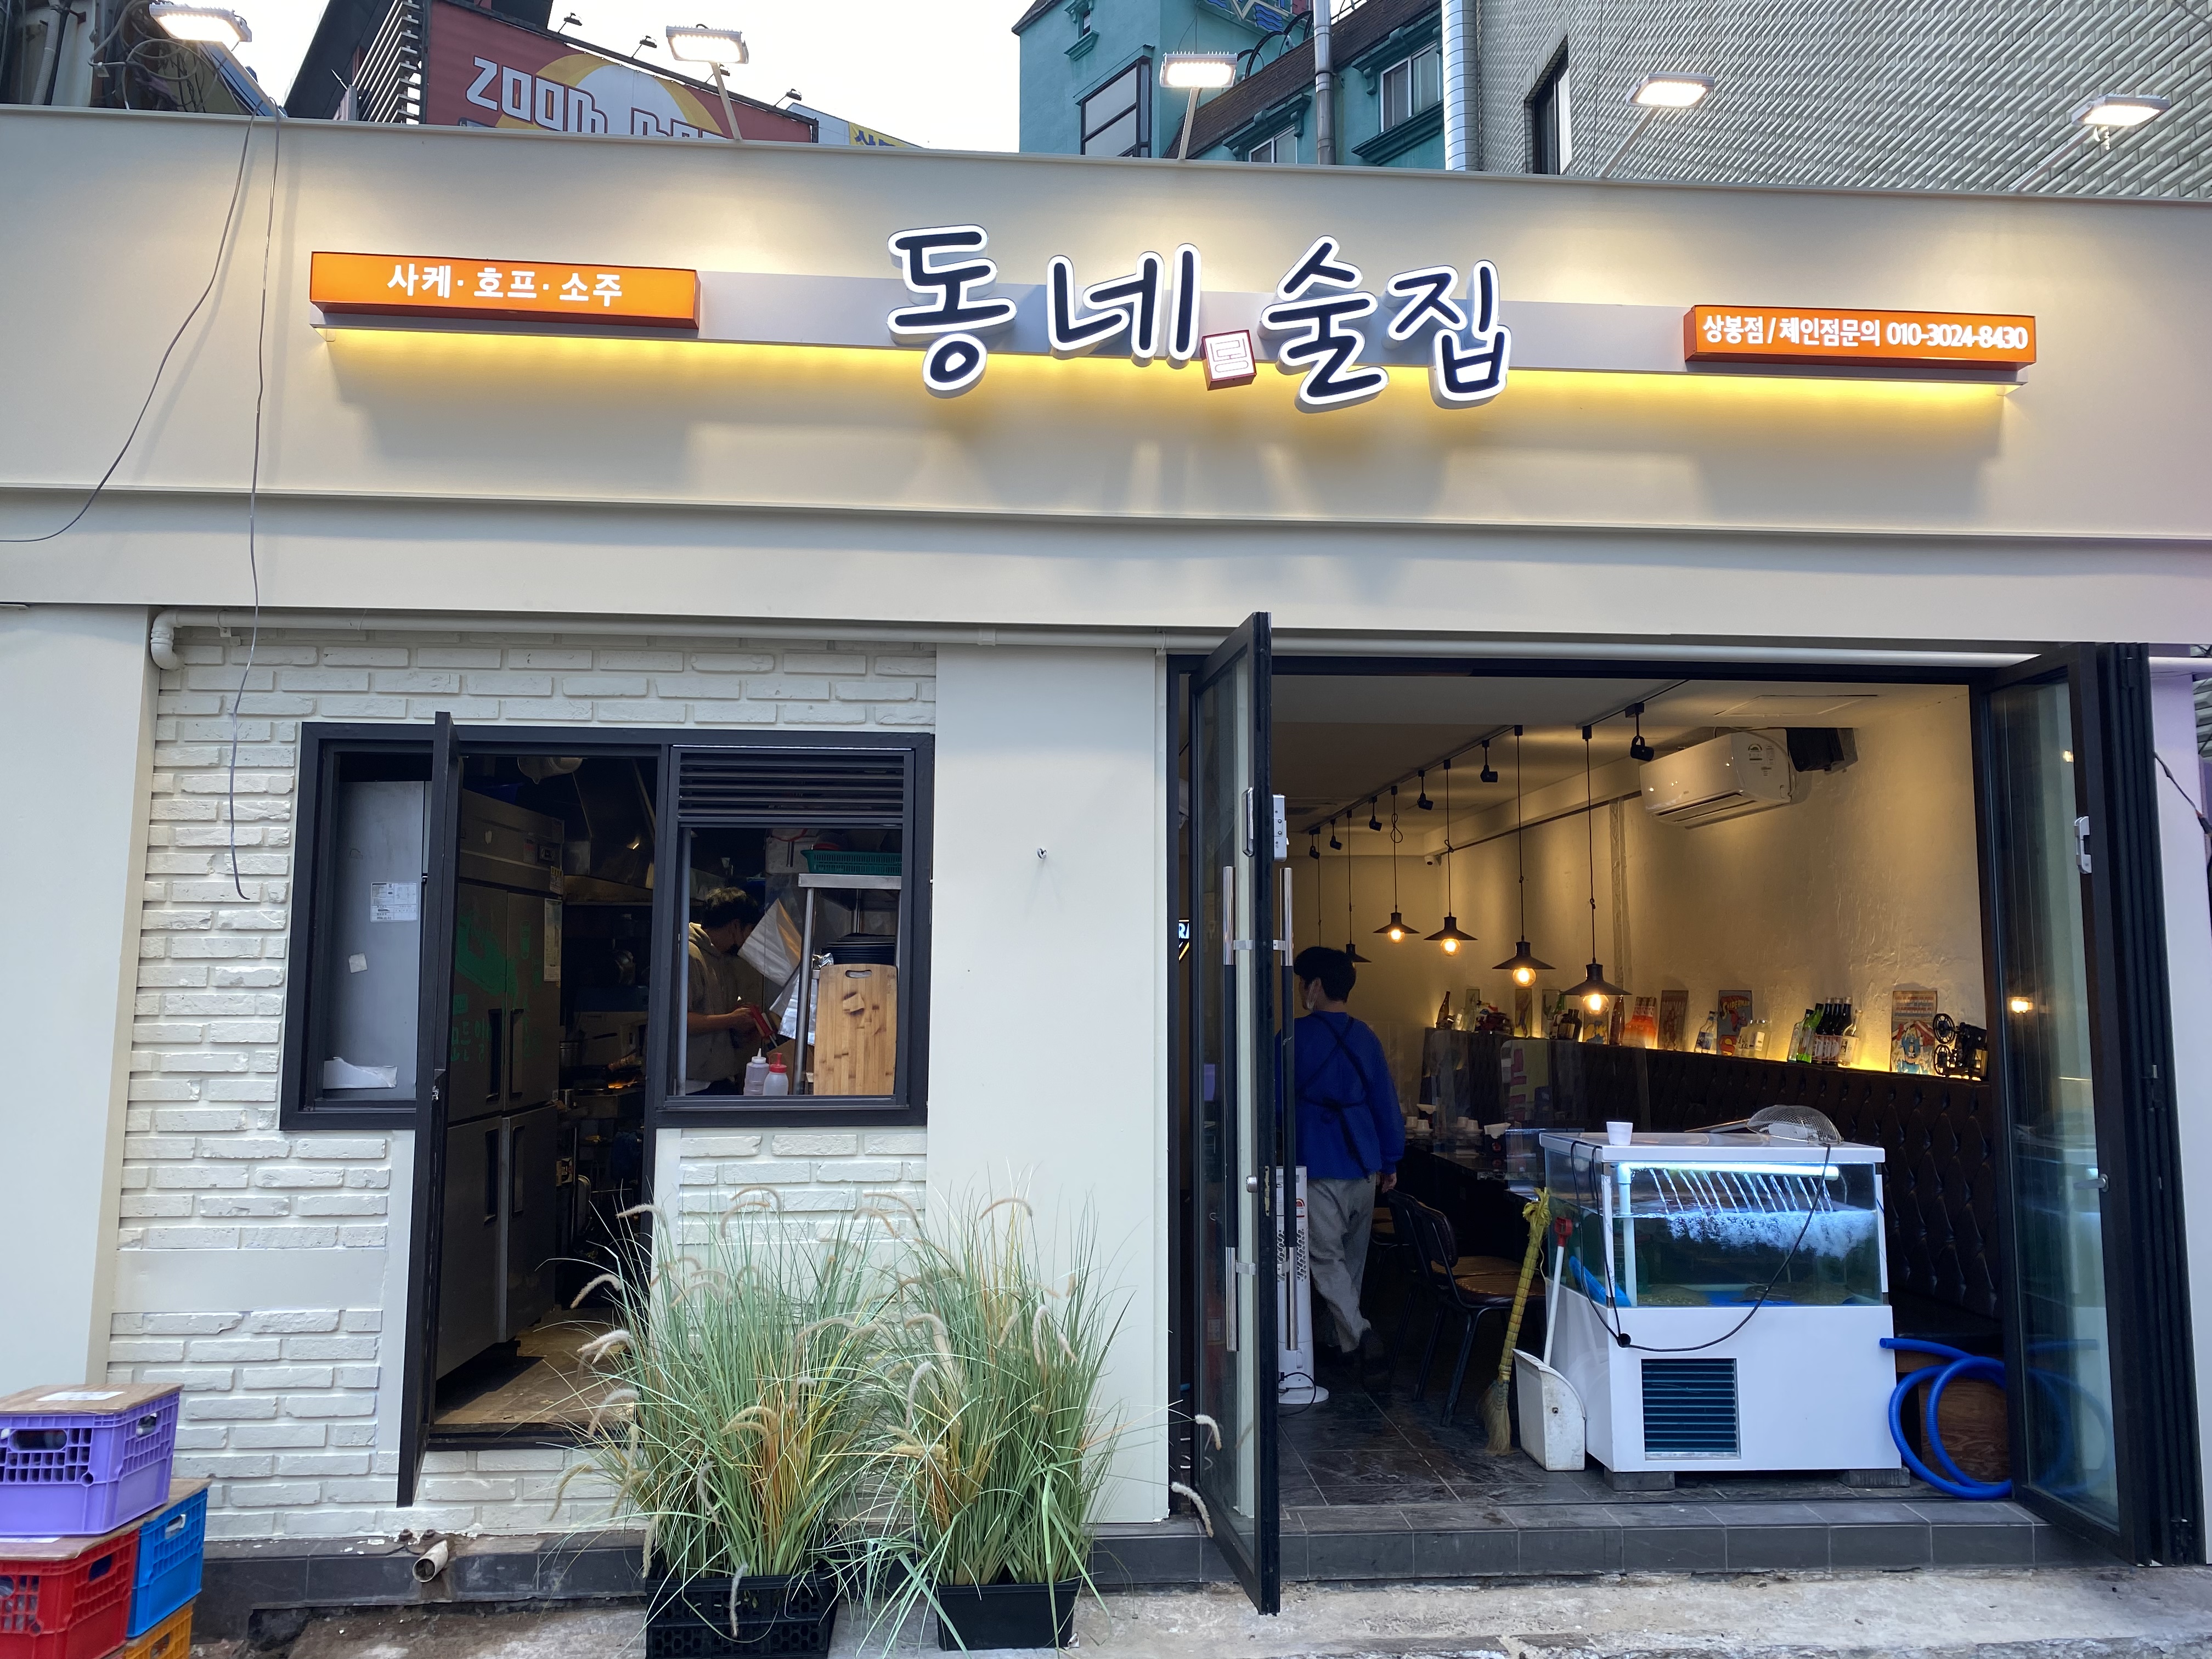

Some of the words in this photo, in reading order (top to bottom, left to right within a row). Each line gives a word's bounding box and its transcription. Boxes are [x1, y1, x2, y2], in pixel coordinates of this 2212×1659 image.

[558, 272, 623, 307] 소주
[887, 224, 1201, 393] 동네
[1261, 235, 1513, 405] 술집
[1886, 321, 2029, 349] 010-3024-8430
